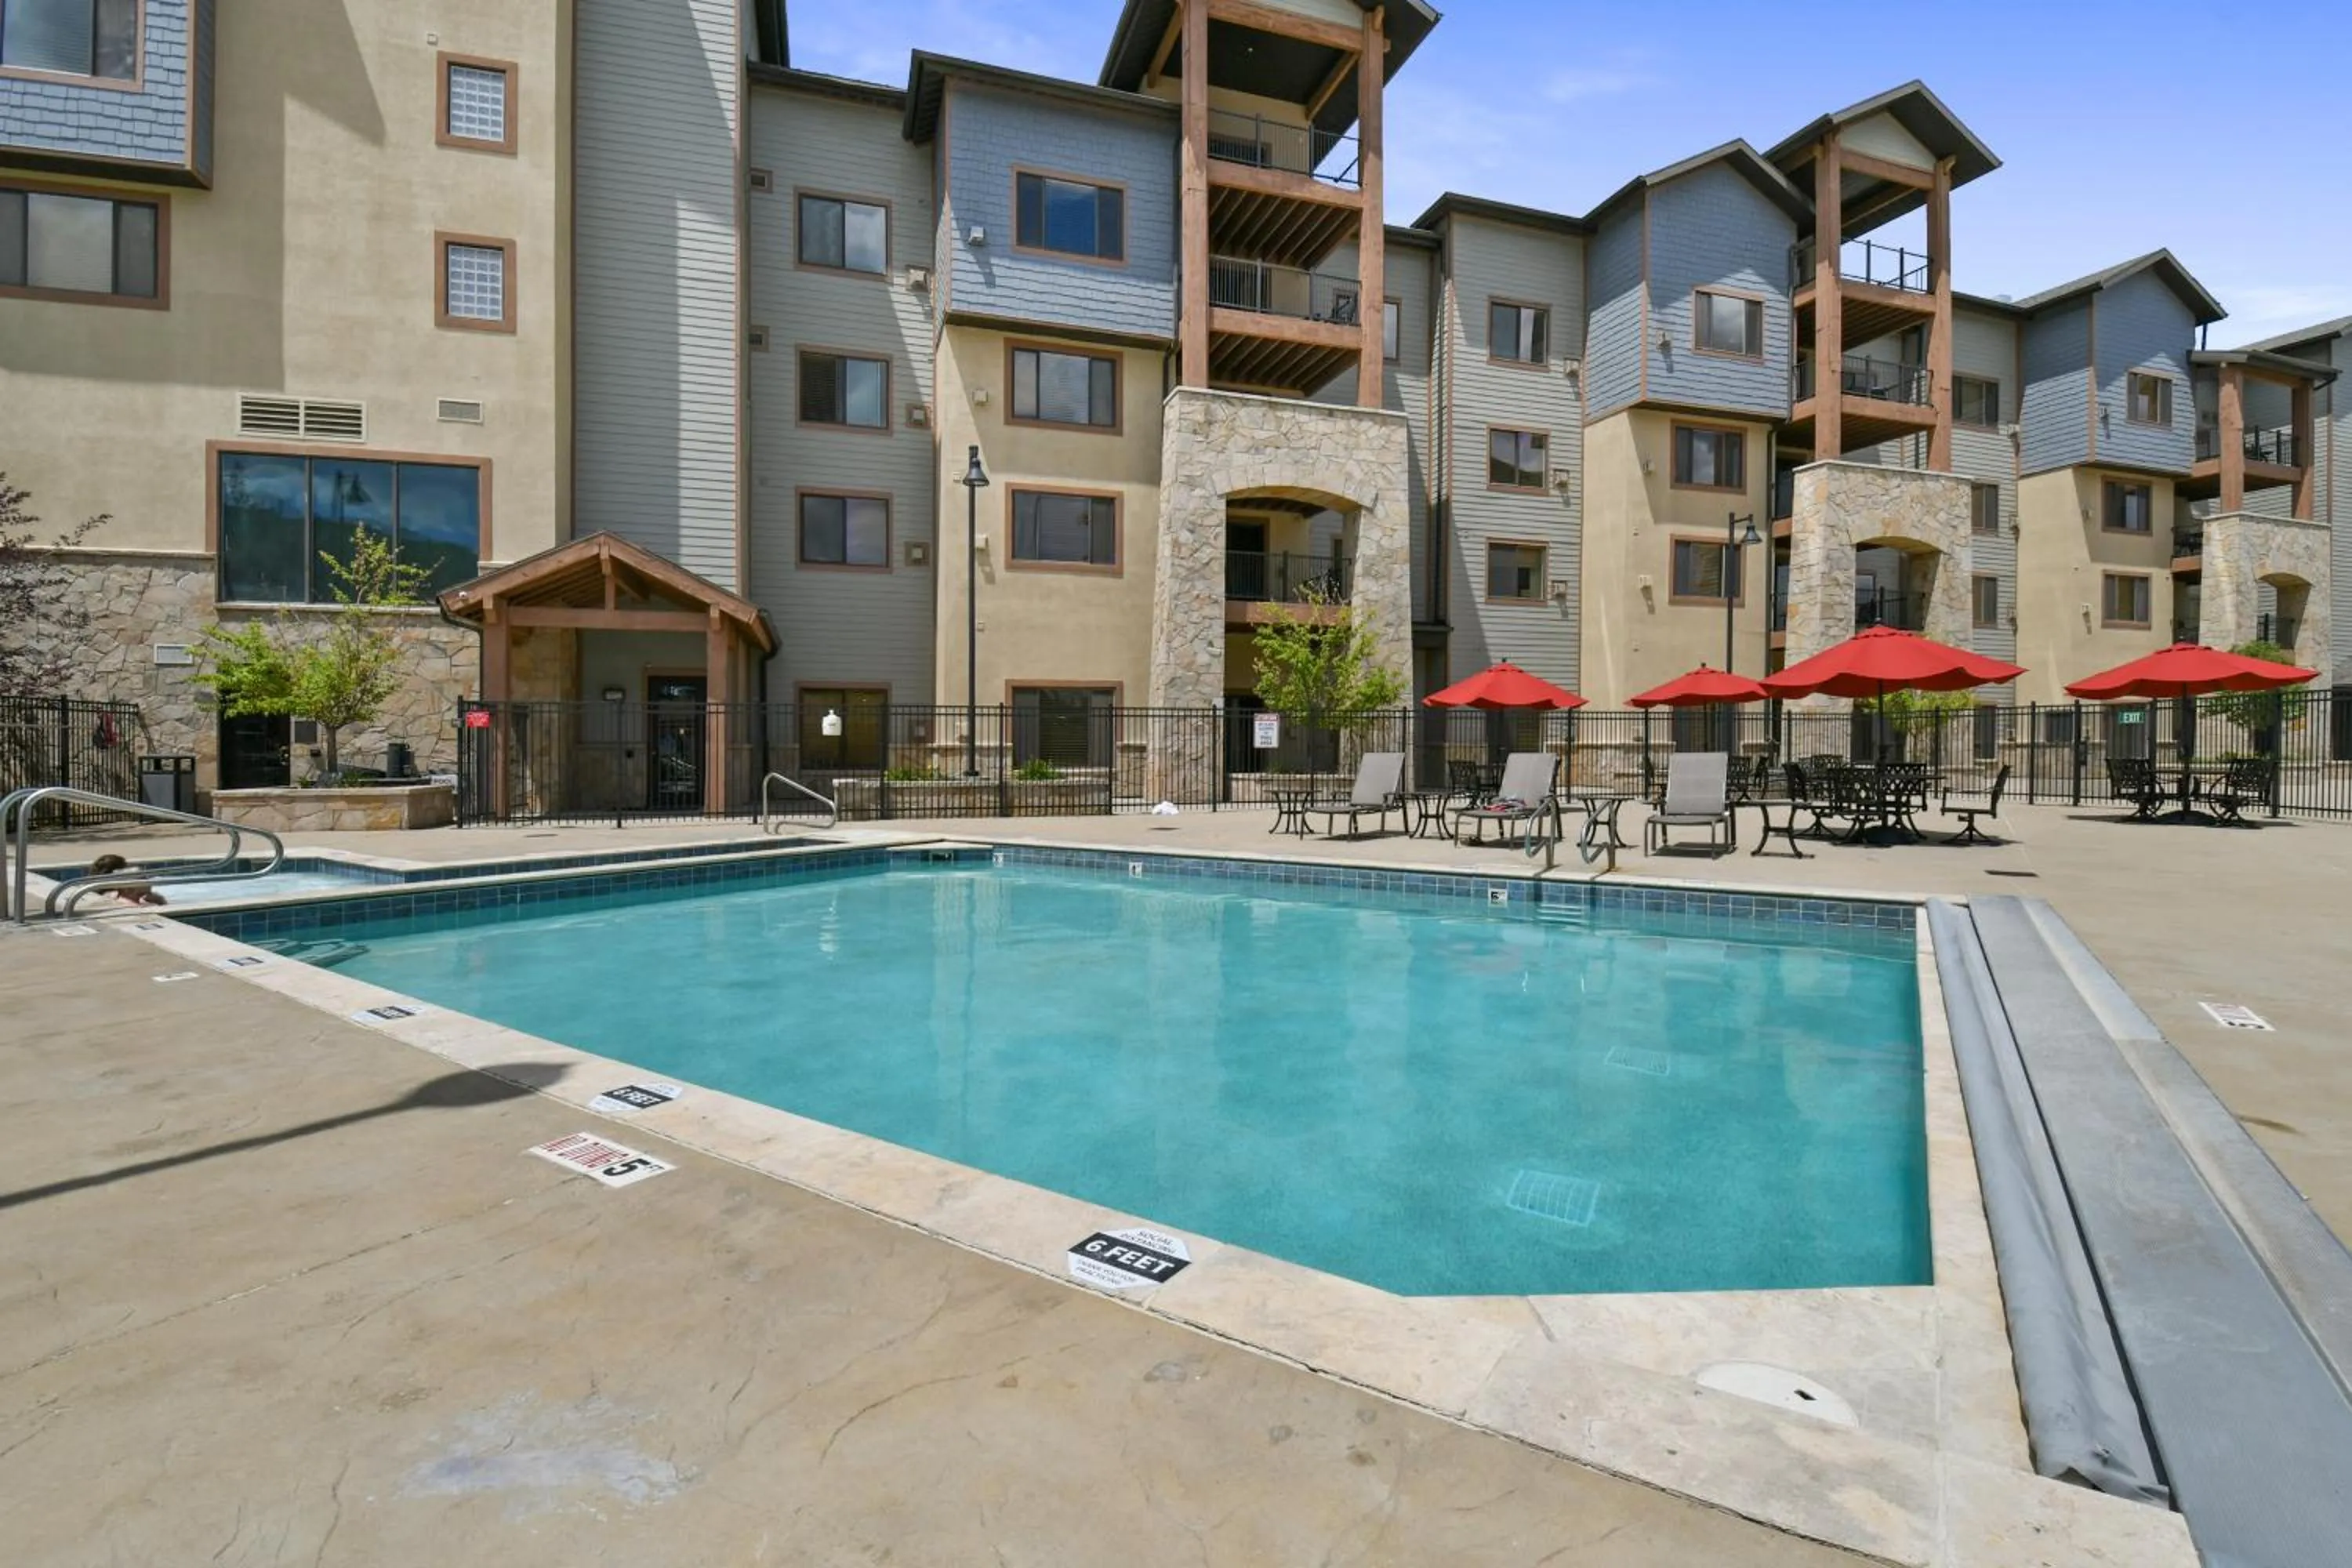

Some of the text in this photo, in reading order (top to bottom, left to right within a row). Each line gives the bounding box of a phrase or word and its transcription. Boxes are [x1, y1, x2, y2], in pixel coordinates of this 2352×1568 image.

[2123, 711, 2140, 723] EXIT
[603, 1158, 652, 1177] 5
[1138, 1231, 1174, 1246] SOCIAL
[1085, 1240, 1175, 1274] 6 FEET
